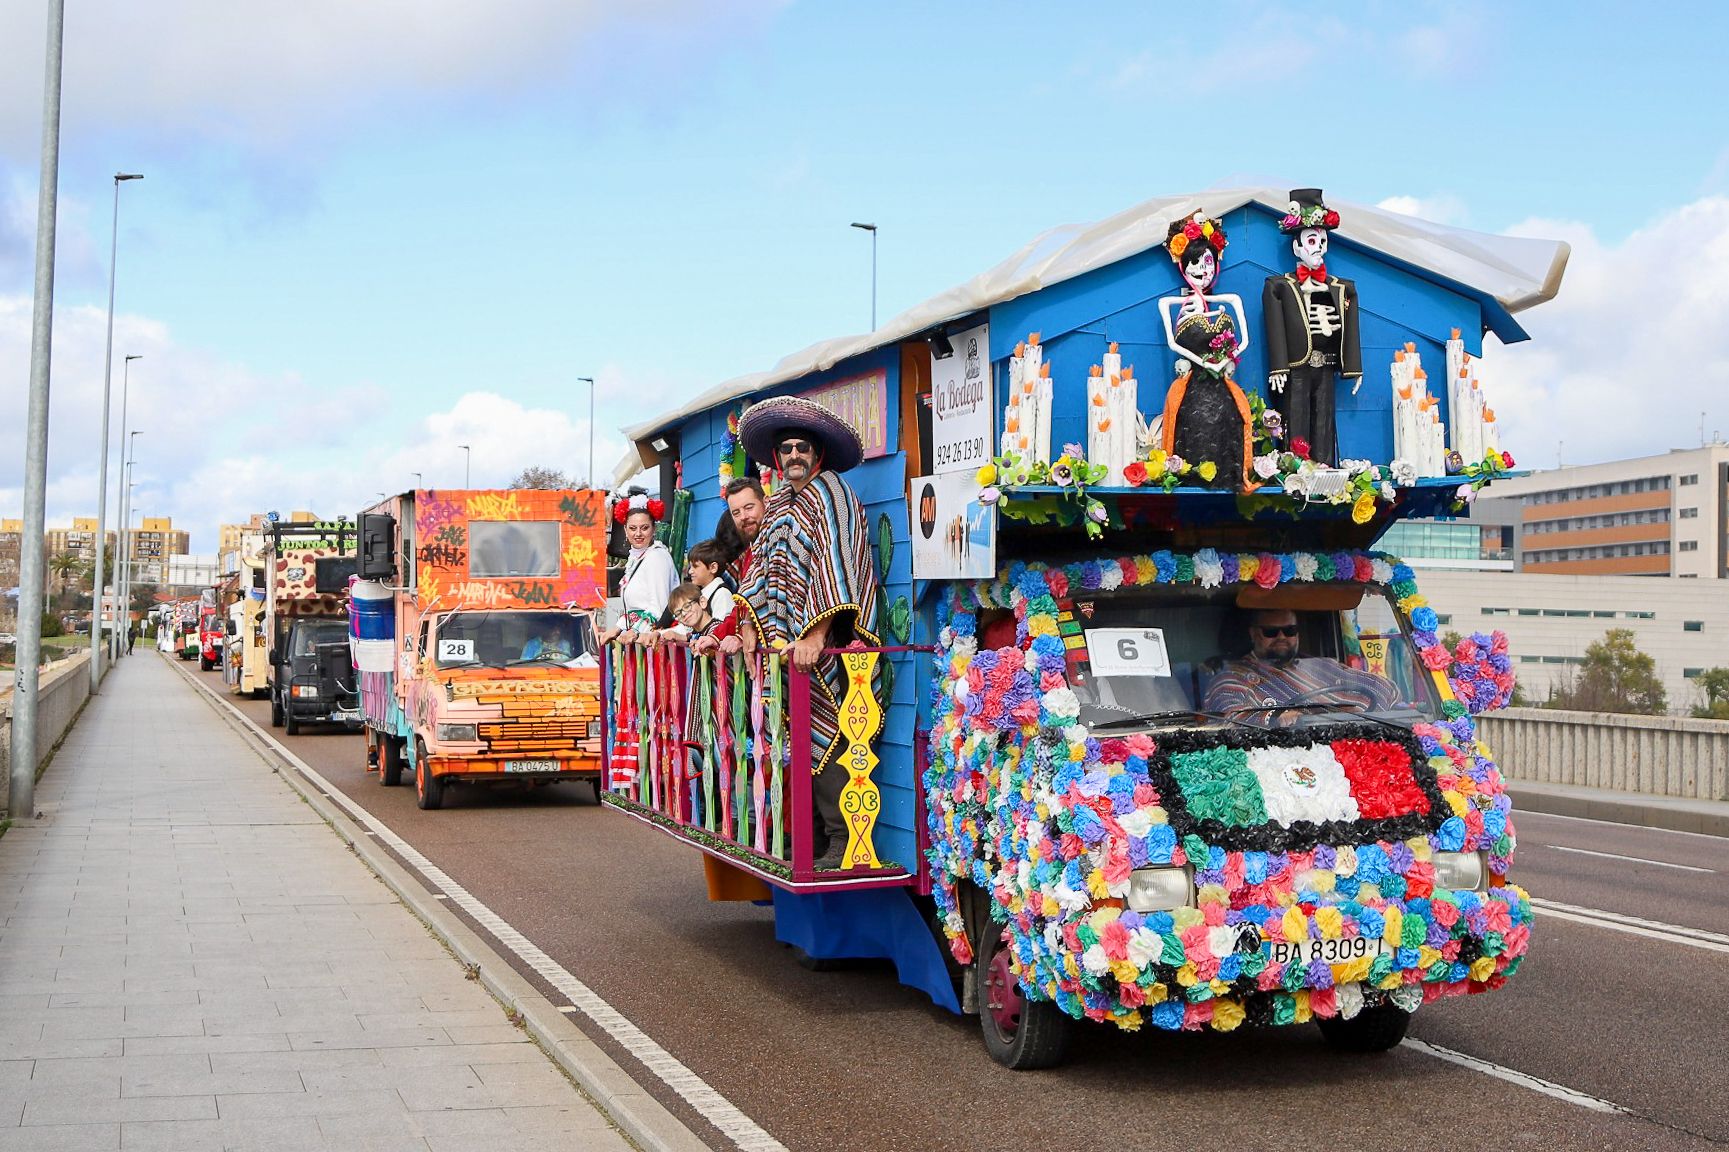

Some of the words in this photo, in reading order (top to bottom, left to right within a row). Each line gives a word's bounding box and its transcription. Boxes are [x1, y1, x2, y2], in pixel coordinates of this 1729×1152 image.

[948, 378, 983, 413] Bodega
[937, 444, 950, 465] 924
[953, 442, 961, 462] 26
[964, 440, 971, 460] 13
[974, 437, 983, 458] 90
[314, 521, 357, 531] SAFA
[278, 540, 328, 551] JUNTOS
[333, 539, 340, 548] Y
[446, 644, 466, 655] 28
[1117, 639, 1138, 660] 6
[512, 762, 523, 771] BA
[527, 761, 549, 771] 0475
[552, 761, 558, 771] U
[1275, 943, 1301, 963] BA
[1311, 937, 1366, 960] 8309
